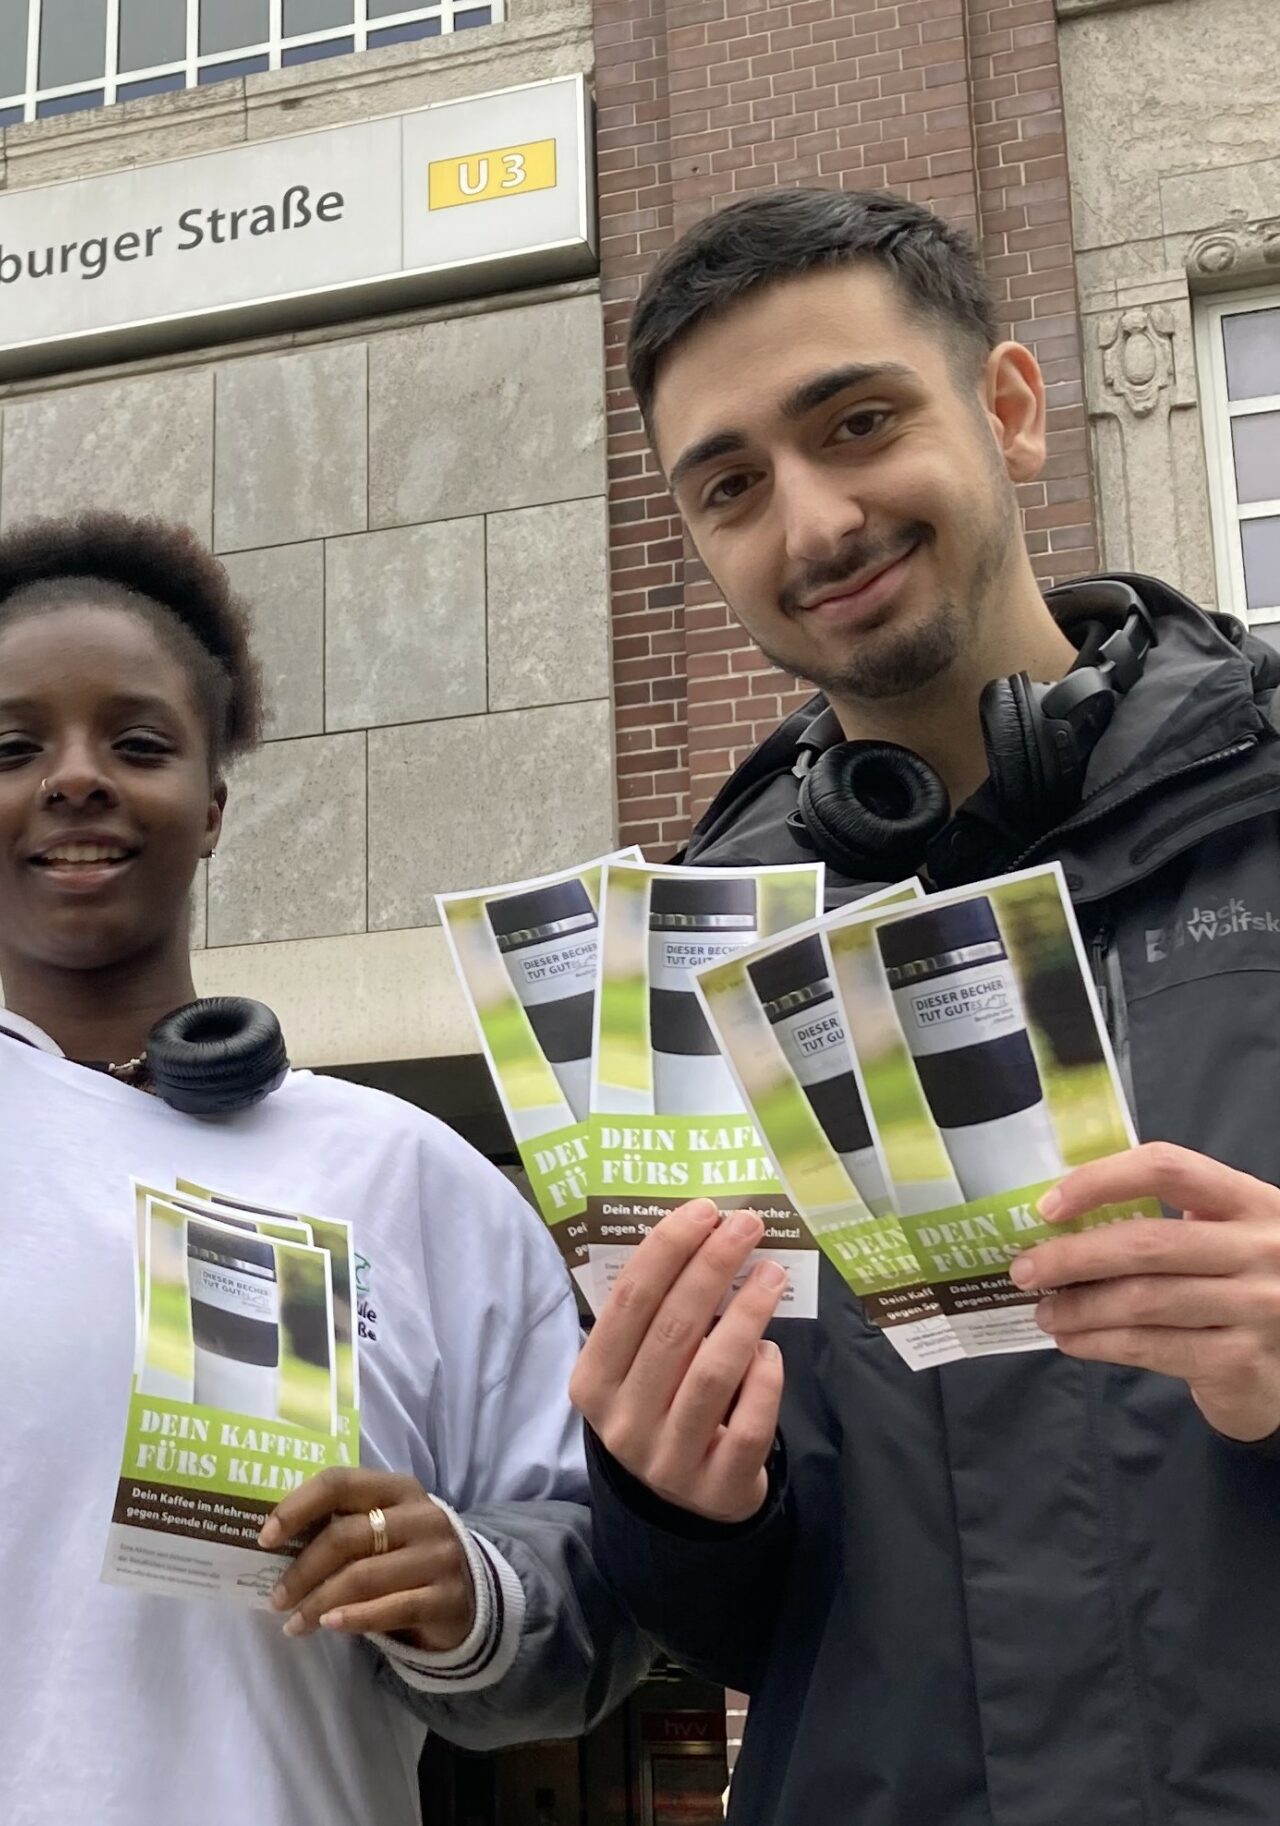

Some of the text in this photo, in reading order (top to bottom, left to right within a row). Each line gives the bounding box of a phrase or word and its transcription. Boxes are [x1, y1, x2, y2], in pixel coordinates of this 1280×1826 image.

[177, 184, 347, 253] Straße
[1187, 898, 1246, 925] Jack
[523, 954, 559, 970] DIESER
[666, 945, 704, 955] DIESER
[666, 956, 687, 965] TUT
[527, 968, 546, 980] TUT
[916, 979, 1004, 1011] DIESER BECHER
[919, 1009, 943, 1023] TUT
[798, 1017, 839, 1041] DIESER
[803, 1028, 845, 1052] TUT GU
[600, 1127, 677, 1151] DEIN
[534, 1135, 590, 1175] DEI
[602, 1154, 689, 1186] FÜRS
[548, 1166, 588, 1209] FÜ
[602, 1204, 631, 1215] Dein
[601, 1225, 636, 1236] gegen
[916, 1213, 1000, 1249] DEIN
[202, 1270, 234, 1288] DIESER
[854, 1254, 921, 1285] FÜR
[203, 1278, 219, 1289] TUT
[949, 1284, 980, 1294] Dein
[878, 1295, 908, 1306] Dein
[953, 1295, 993, 1309] gegen
[886, 1306, 922, 1321] gegen
[139, 1409, 210, 1441] DEIN
[220, 1423, 326, 1465] KAFFEE
[136, 1440, 317, 1490] FÜRS KLIM
[132, 1488, 269, 1525] Dein Kaffee im Mehrweg
[126, 1507, 160, 1521] gegen
[161, 1511, 201, 1530] Spende
[203, 1519, 219, 1532] für
[220, 1523, 240, 1536] den
[664, 1719, 708, 1737] hvv
